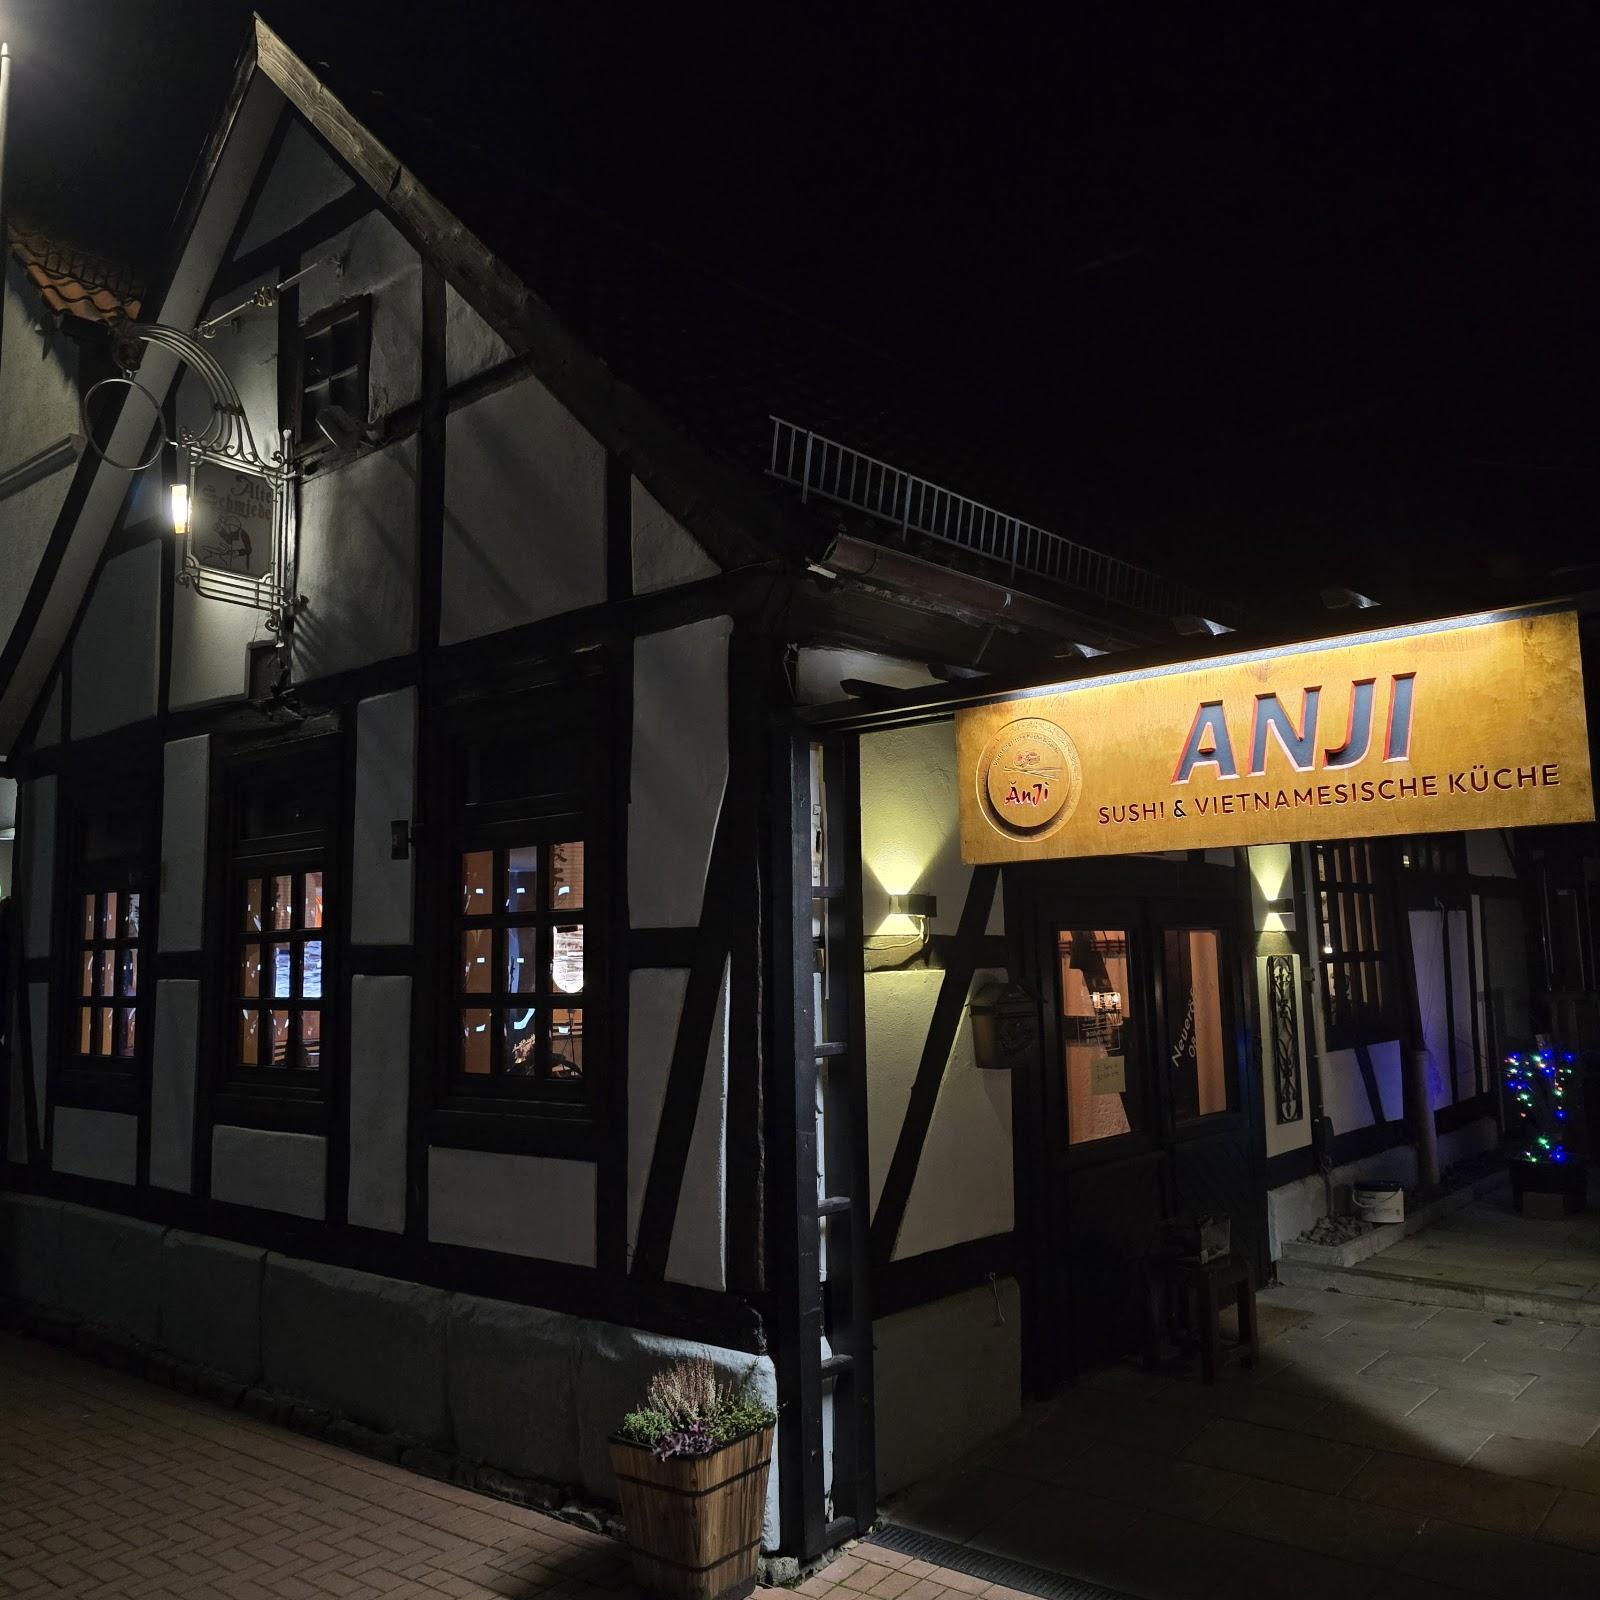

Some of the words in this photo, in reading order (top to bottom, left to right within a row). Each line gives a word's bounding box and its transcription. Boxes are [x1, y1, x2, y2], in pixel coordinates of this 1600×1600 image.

[202, 484, 271, 519] Schmiede
[230, 474, 272, 504] Alte
[1170, 671, 1417, 785] ANJI
[1099, 801, 1164, 824] SUSHI
[1173, 799, 1187, 818] &
[1195, 775, 1438, 817] VIETNAMESISCHE
[1449, 763, 1560, 795] KÜCHE
